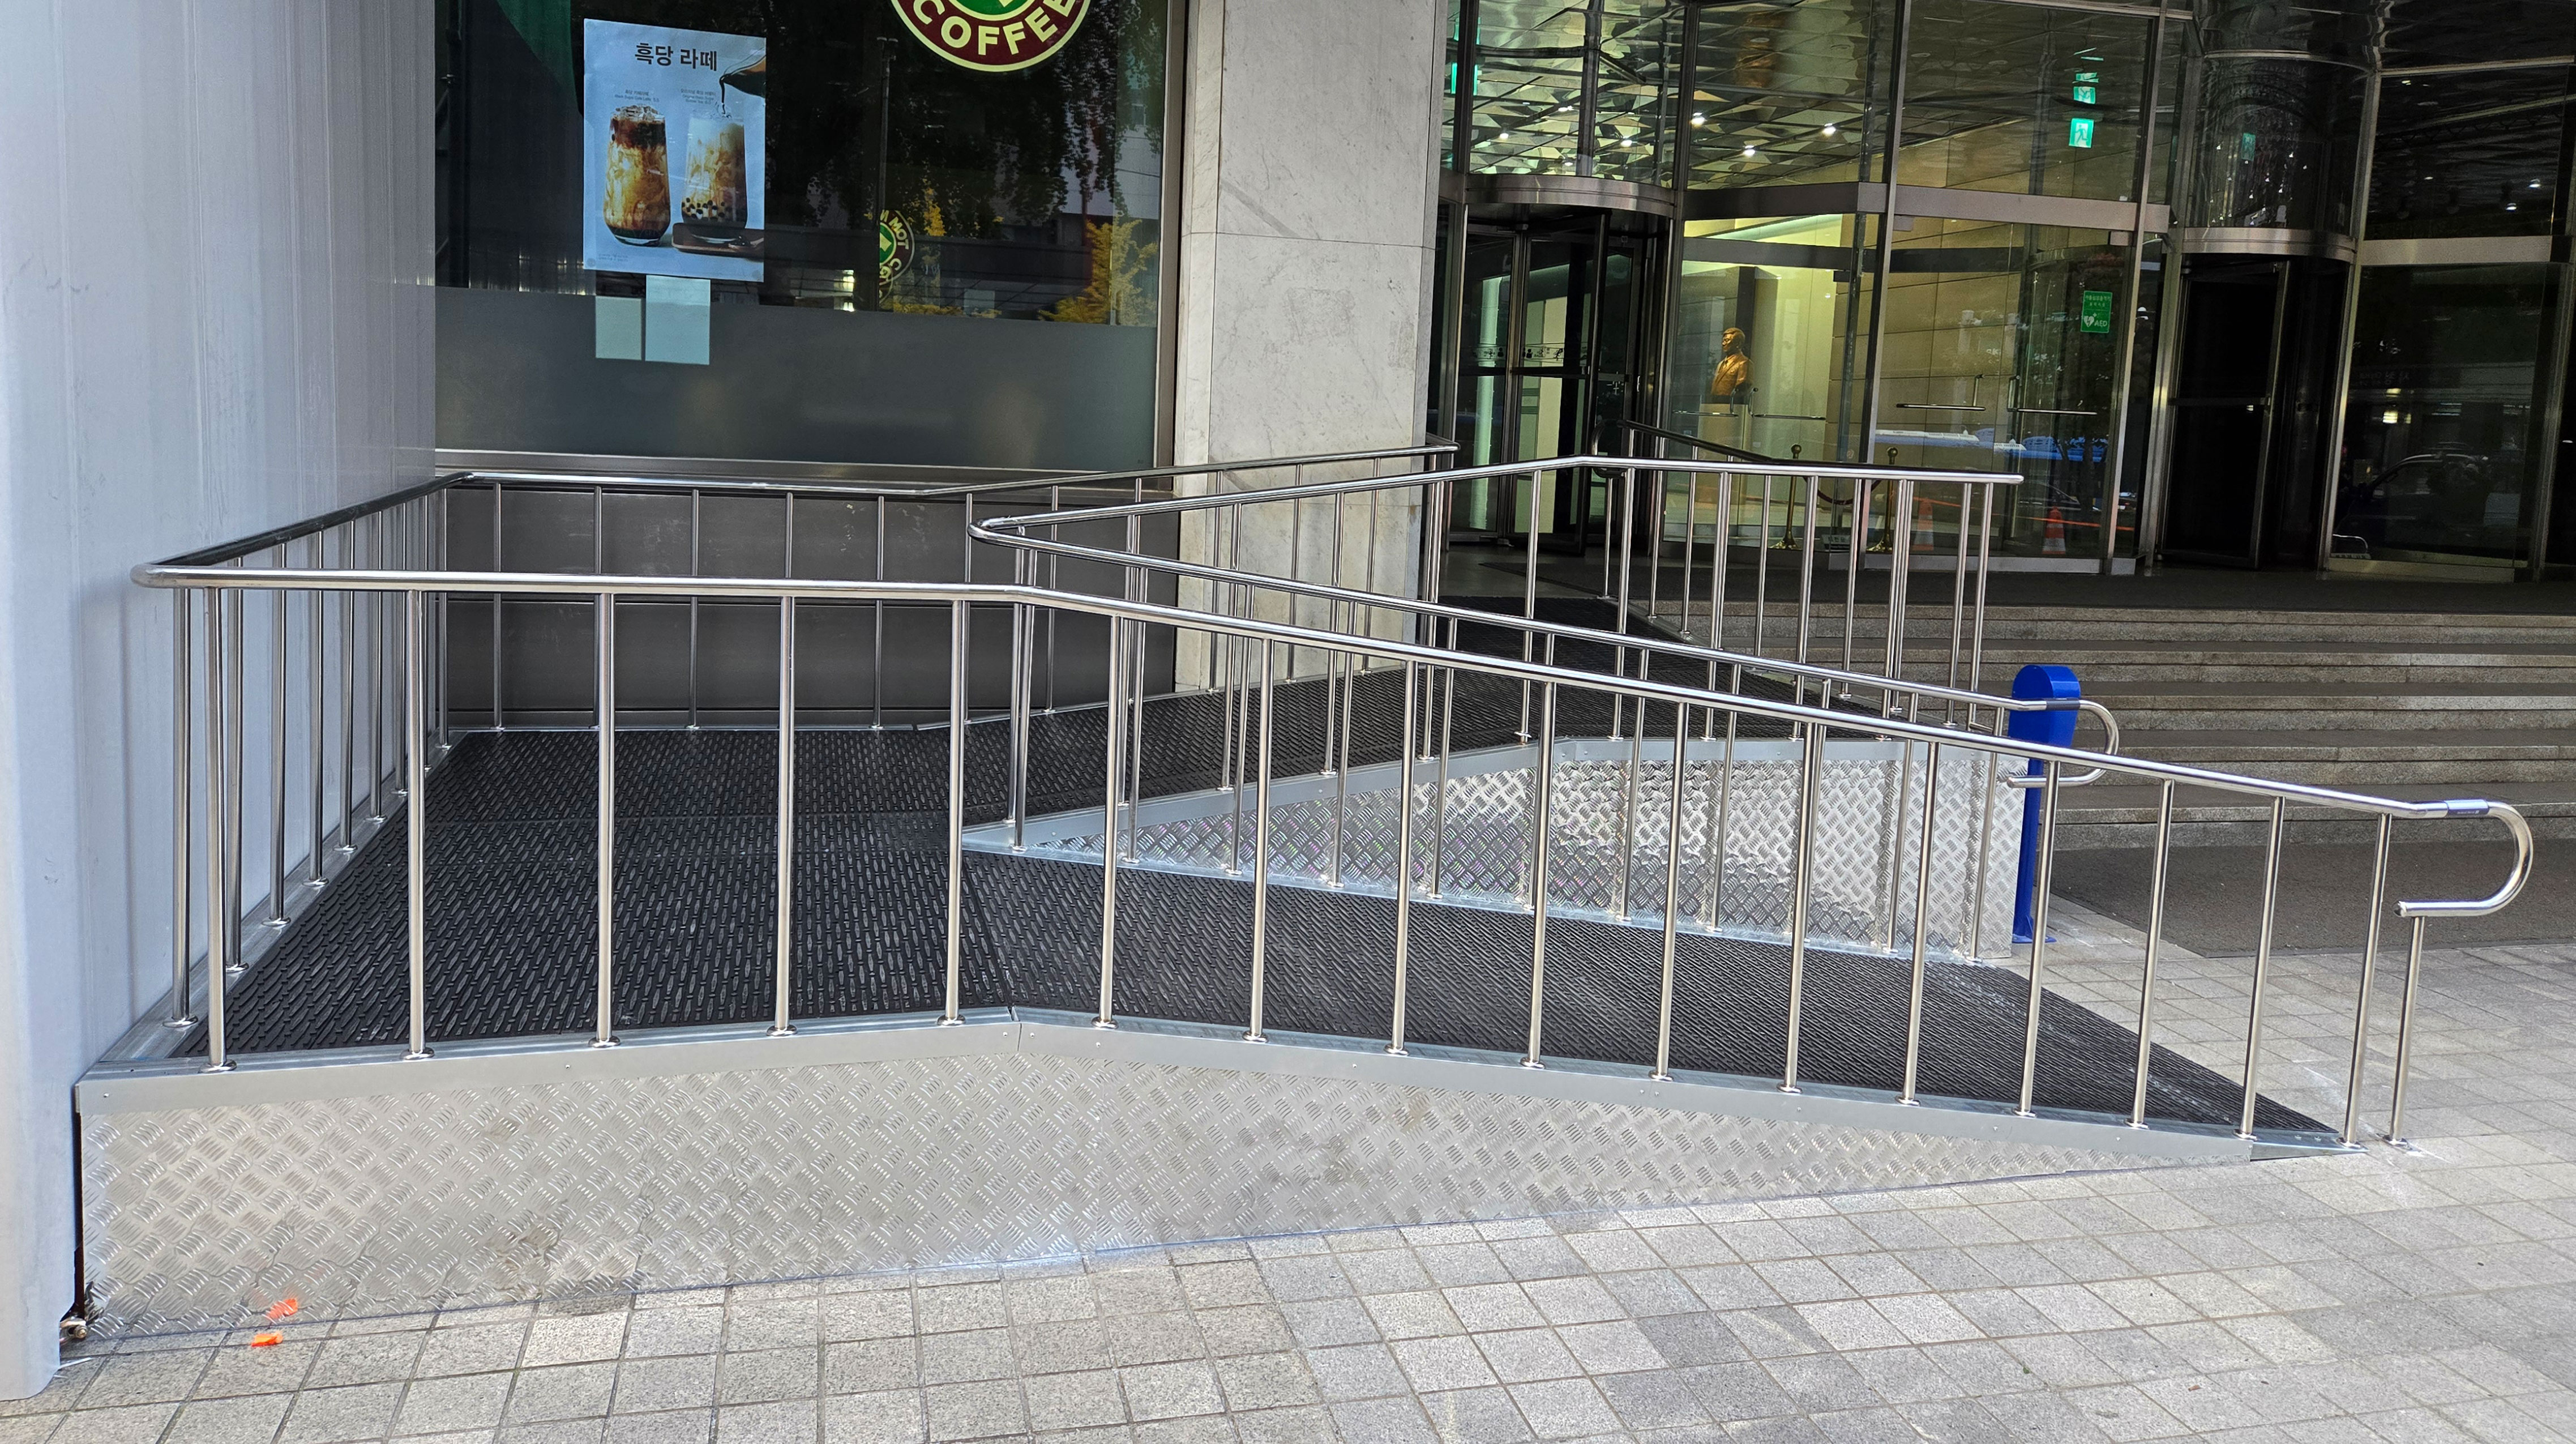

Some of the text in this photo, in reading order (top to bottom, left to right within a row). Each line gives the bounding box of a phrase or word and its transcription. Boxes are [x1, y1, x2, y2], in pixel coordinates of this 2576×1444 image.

[913, 0, 1075, 55] COFFEE
[635, 42, 717, 71] 흑당 라떼
